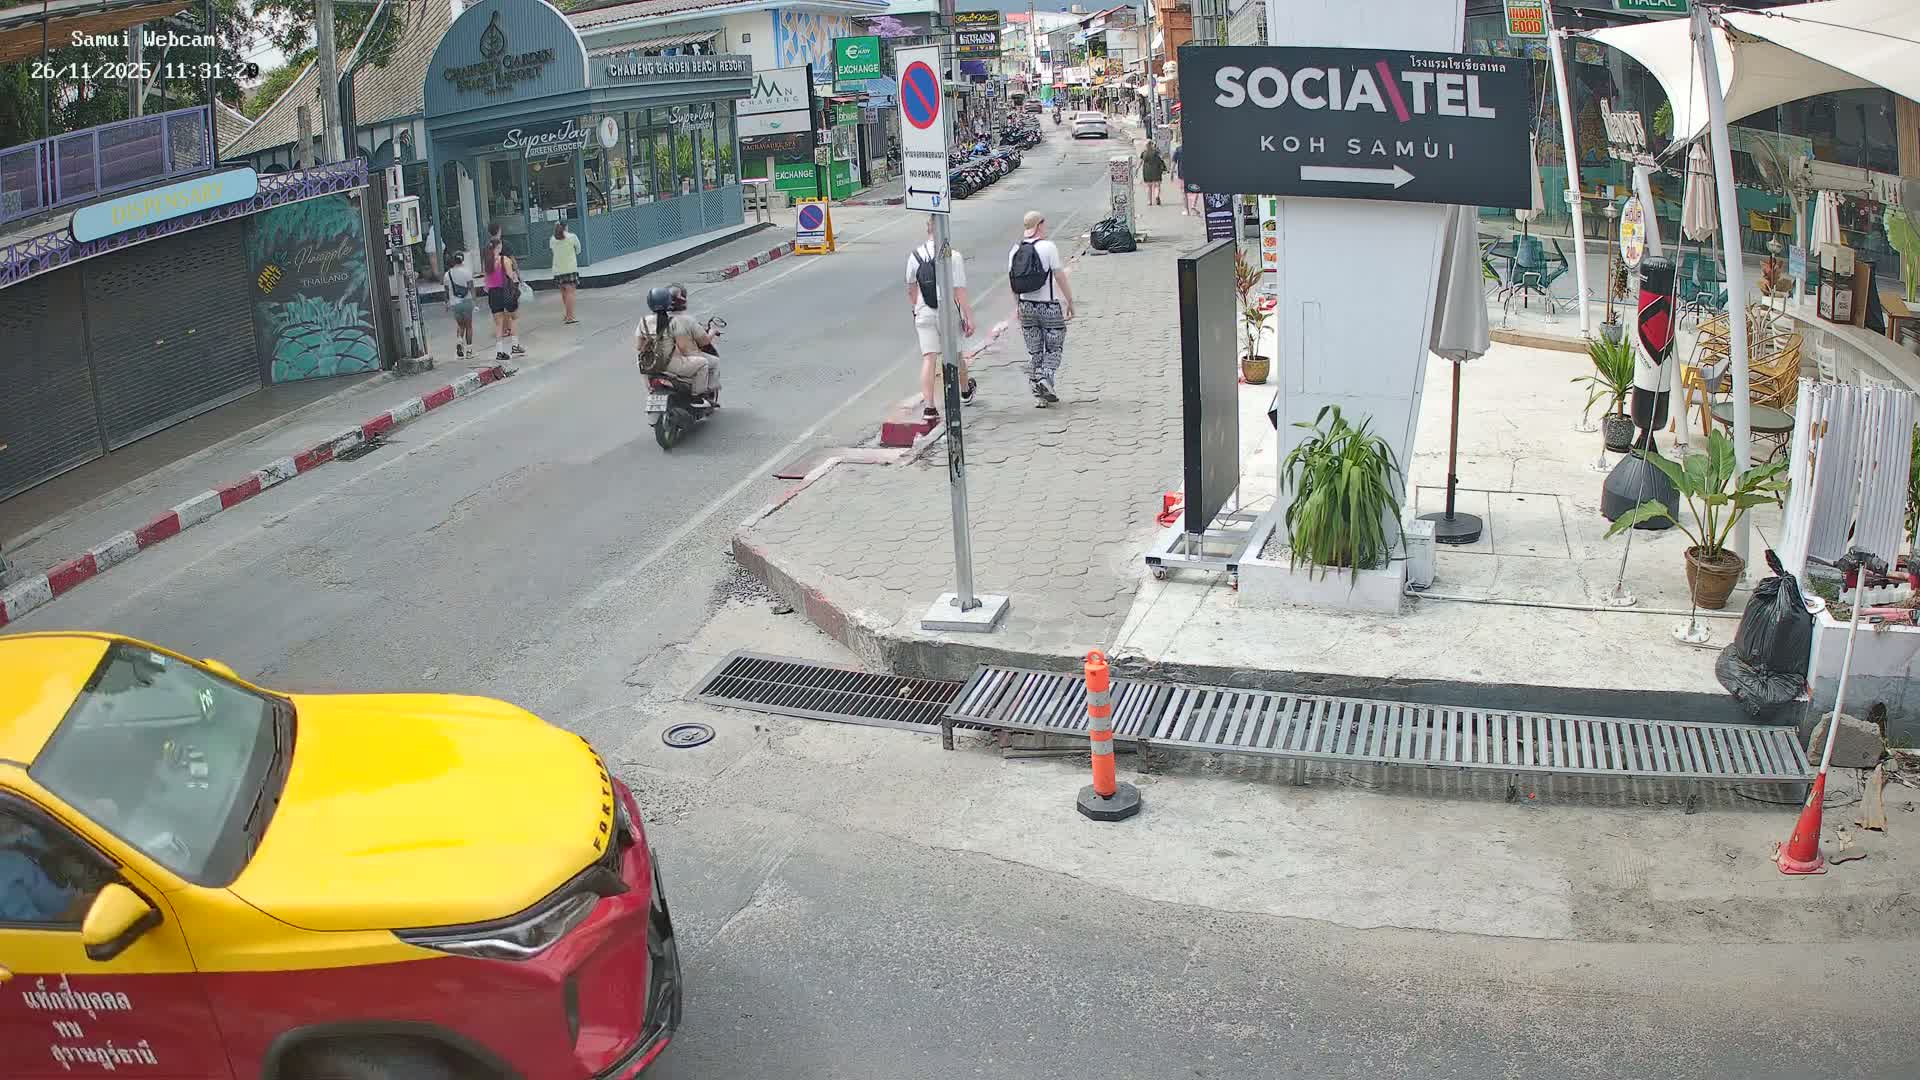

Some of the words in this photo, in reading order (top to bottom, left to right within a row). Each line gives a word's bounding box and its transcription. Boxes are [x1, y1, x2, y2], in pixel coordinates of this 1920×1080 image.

[1508, 7, 1542, 19] INDIAN
[1511, 20, 1542, 33] FOOD
[610, 62, 654, 76] CHAWENG
[657, 61, 690, 73] GARDEN
[692, 60, 717, 72] BEACH
[719, 59, 746, 72] RESORT
[838, 63, 879, 75] EXCHANGE
[503, 119, 592, 160] SuperJay
[1260, 135, 1325, 153] KOH
[1347, 138, 1454, 159] SAMUI
[775, 169, 814, 180] EXCHANGE
[909, 169, 918, 178] NO
[918, 170, 942, 180] PARKING
[111, 179, 225, 226] DISPENSARY
[303, 272, 348, 288] THAILAND
[579, 735, 611, 852] FORTUN
